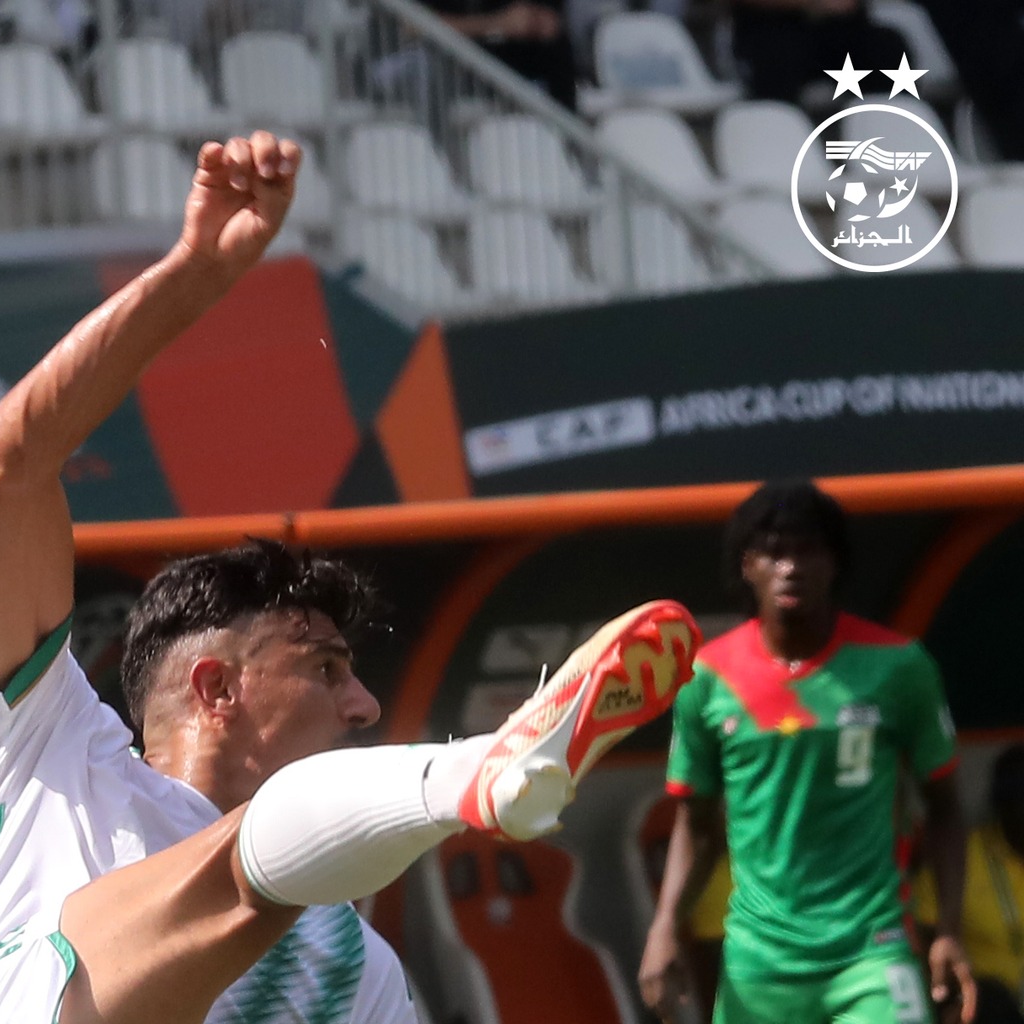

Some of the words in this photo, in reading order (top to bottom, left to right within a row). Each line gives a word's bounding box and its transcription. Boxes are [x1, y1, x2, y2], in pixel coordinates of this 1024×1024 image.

[660, 386, 775, 436] AFRICA
[777, 378, 843, 420] CUP
[845, 373, 894, 417] OF
[836, 727, 874, 787] 9
[887, 966, 924, 1021] 9
